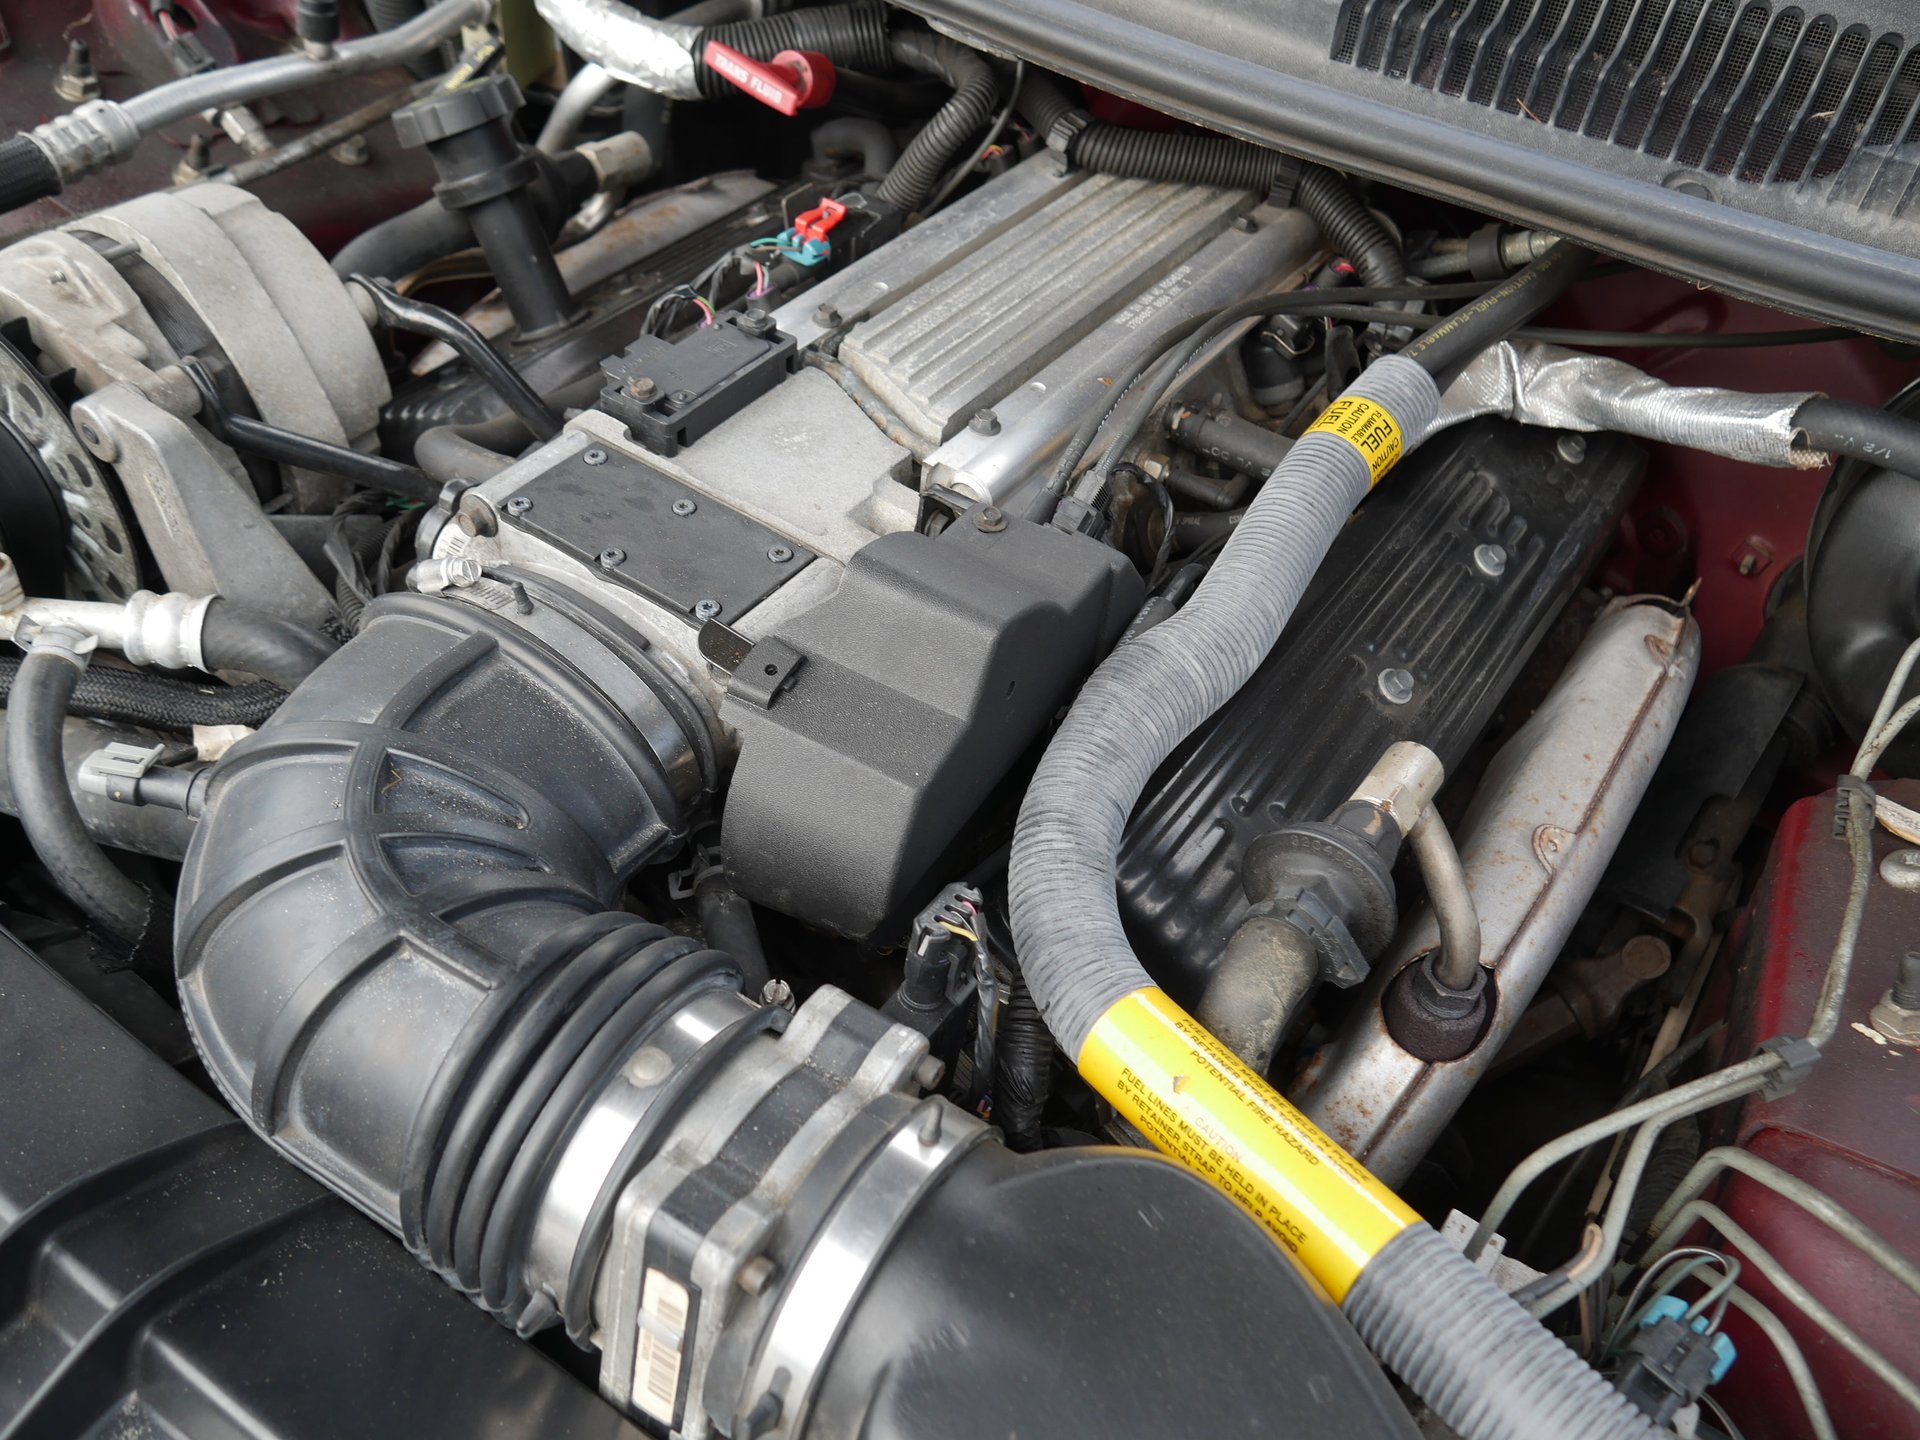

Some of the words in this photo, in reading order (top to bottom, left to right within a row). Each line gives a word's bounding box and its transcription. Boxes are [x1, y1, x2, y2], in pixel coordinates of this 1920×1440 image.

[714, 52, 749, 84] TRANS
[750, 76, 783, 104] FLUID
[1322, 401, 1353, 425] FUEL
[1336, 403, 1370, 434] CAUTION
[1351, 410, 1382, 443] FLAMMABLE
[1360, 419, 1393, 453] FUEL
[1372, 437, 1399, 472] CAUTION
[1174, 1022, 1190, 1034] BY
[1183, 1018, 1207, 1040] FUEL
[1209, 1040, 1240, 1067] LINES
[1240, 1068, 1271, 1094] MUST
[1271, 1096, 1288, 1109] BE
[1288, 1110, 1317, 1136] HELD
[1190, 1050, 1246, 1102] POTENTIAL
[1246, 1102, 1273, 1125] FIRE
[1273, 1125, 1319, 1166] HAZARD
[1117, 1081, 1131, 1095] BY
[1132, 1095, 1181, 1143] RETAINER
[1183, 1143, 1216, 1175] STRAP
[1217, 1174, 1233, 1191] TO
[1121, 1068, 1146, 1095] FUEL
[1149, 1092, 1178, 1123] LINES
[1178, 1122, 1209, 1151] MUST
[1208, 1150, 1225, 1167] BE
[1225, 1164, 1255, 1194] HELD
[1255, 1193, 1269, 1209] IN
[1269, 1206, 1308, 1244] PLACE
[1140, 1115, 1192, 1167] POTENTIAL
[1195, 1117, 1244, 1162] CAUTION
